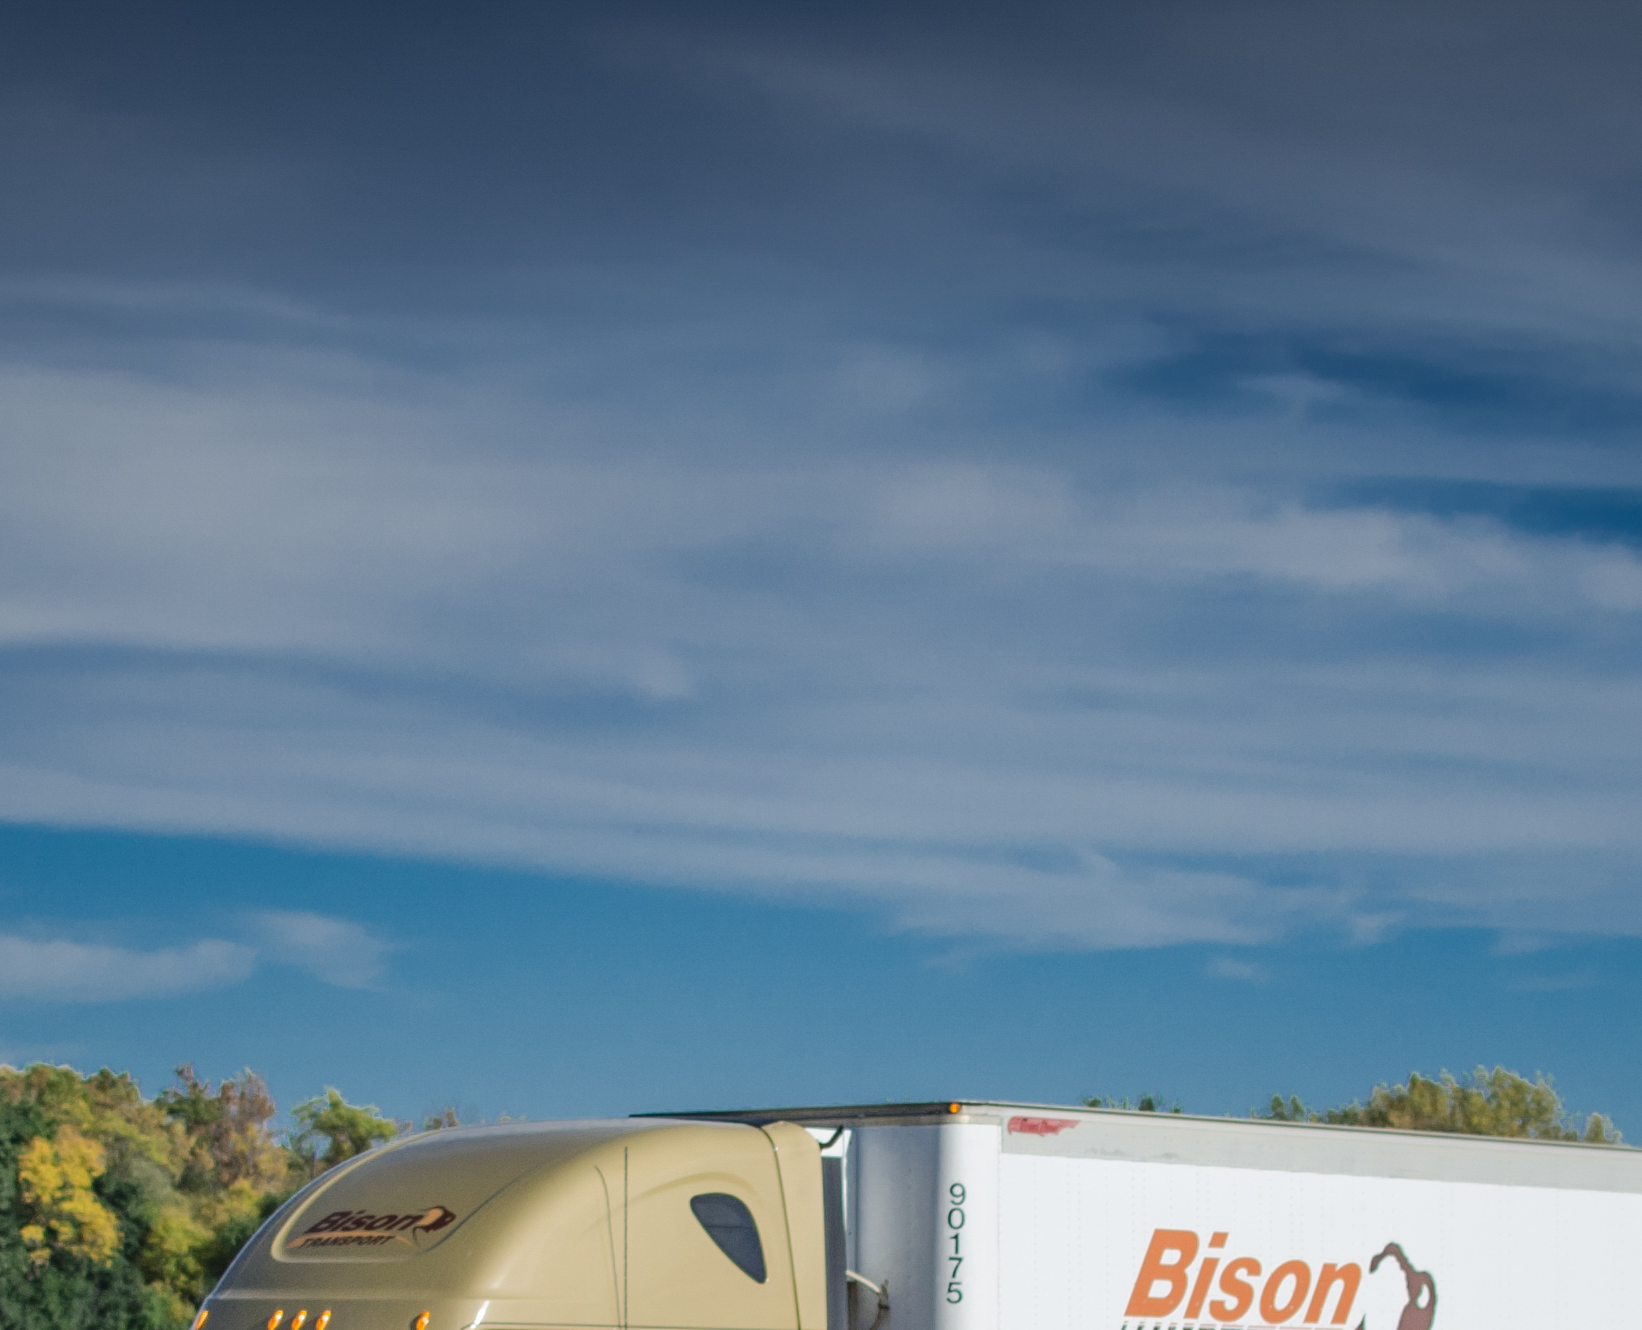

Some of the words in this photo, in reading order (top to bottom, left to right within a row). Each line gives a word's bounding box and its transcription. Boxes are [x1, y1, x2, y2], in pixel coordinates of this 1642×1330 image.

[299, 1235, 398, 1248] TRANSPORT
[303, 1209, 425, 1234] Bison
[946, 1182, 966, 1304] 90175
[1124, 1228, 1362, 1324] Bison
